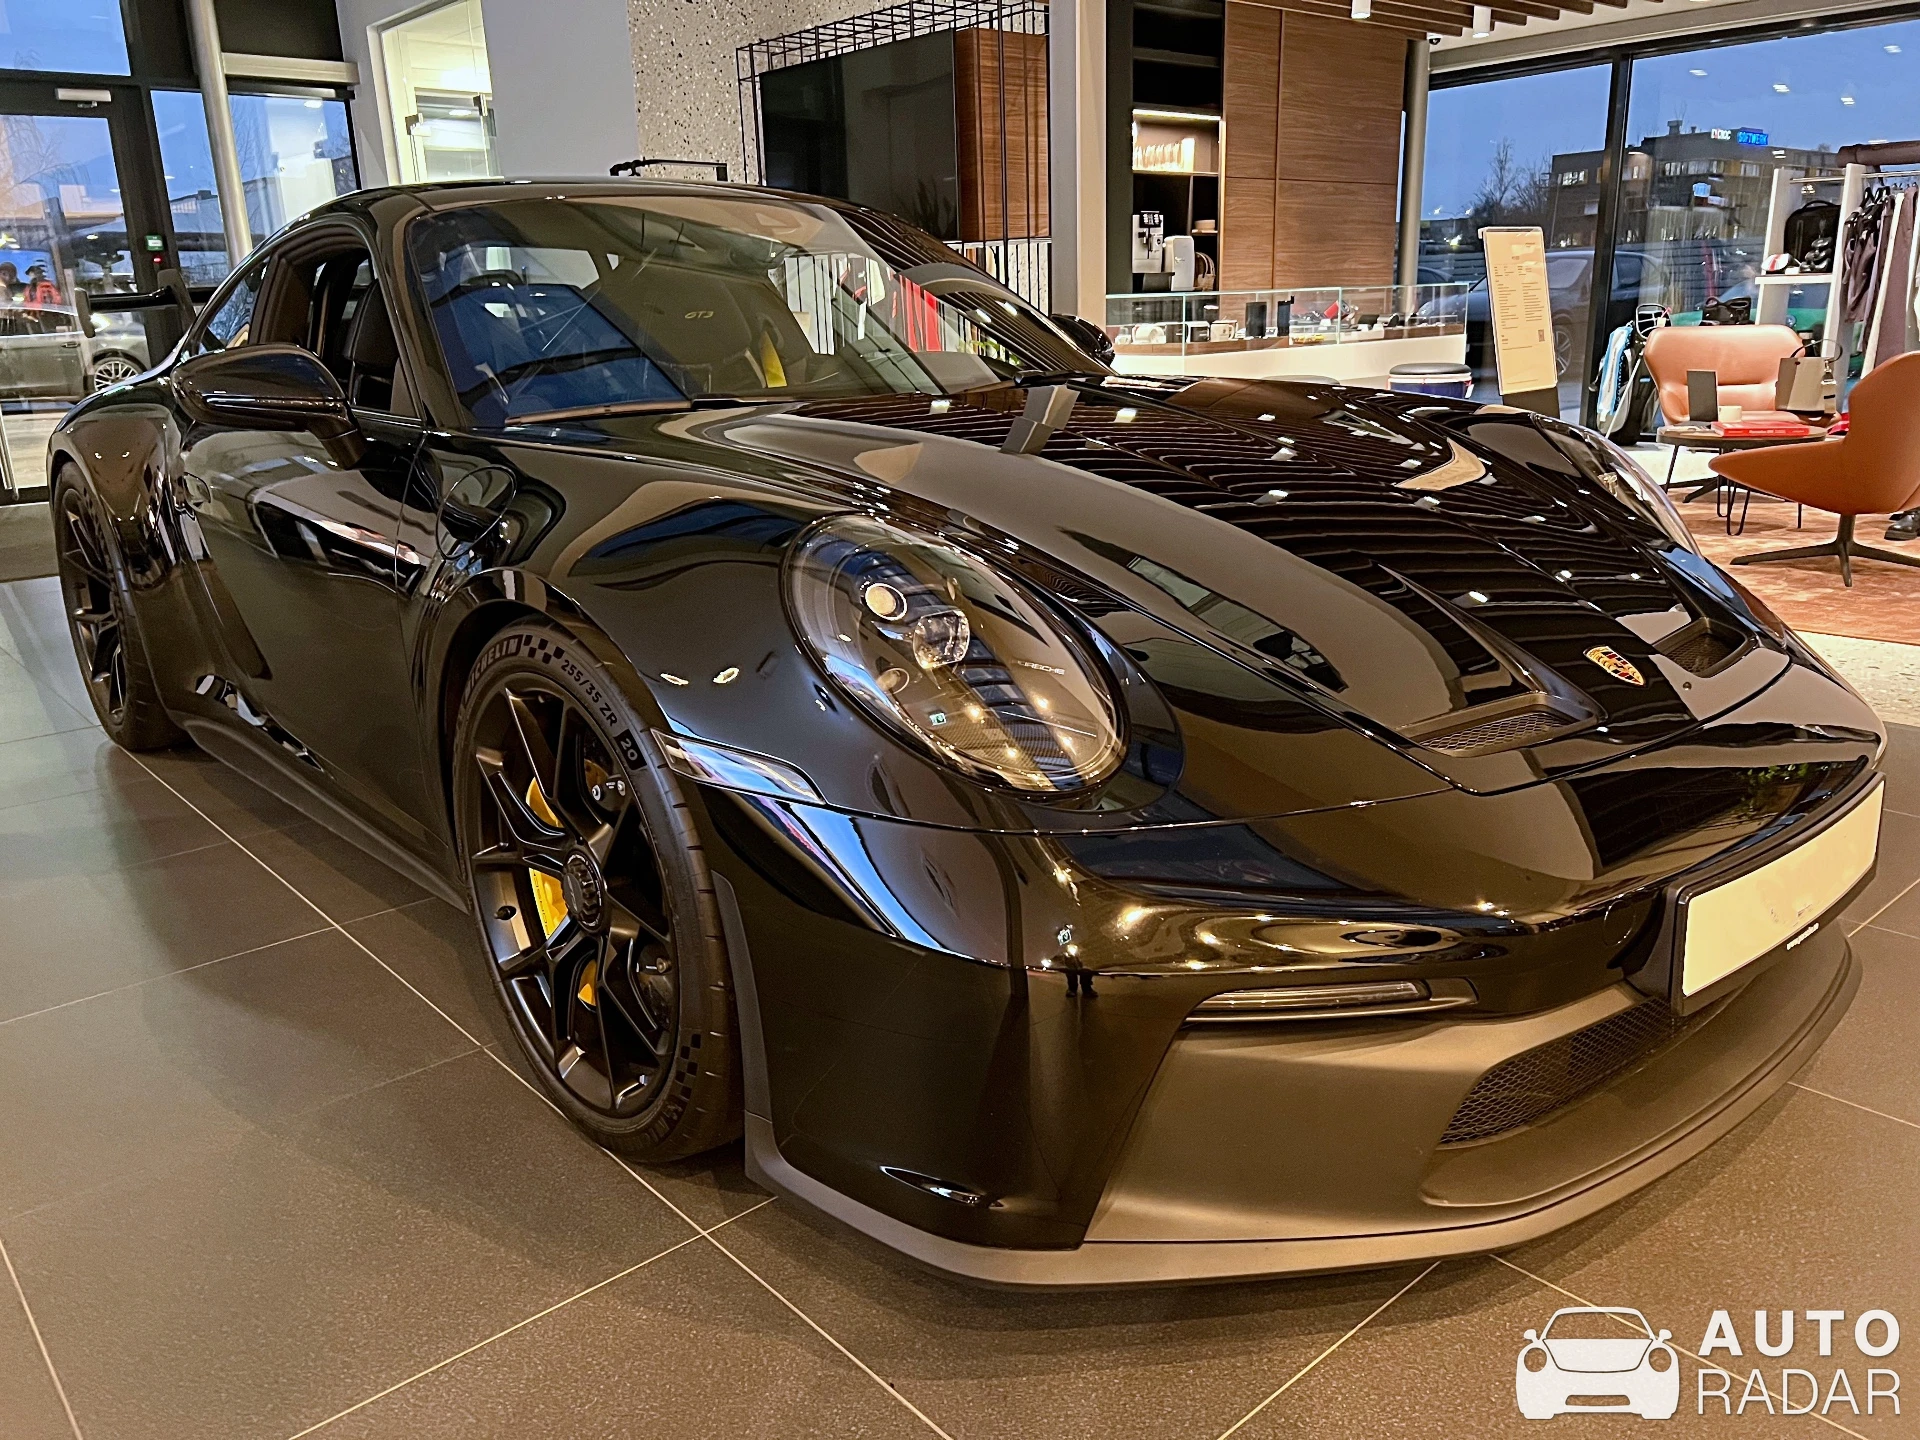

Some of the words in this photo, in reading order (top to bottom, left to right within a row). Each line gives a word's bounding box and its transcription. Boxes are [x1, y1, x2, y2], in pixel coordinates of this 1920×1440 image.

[464, 637, 519, 704] MICHELIN
[561, 659, 603, 704] 255/35
[599, 702, 618, 727] ZR
[620, 737, 638, 761] 20
